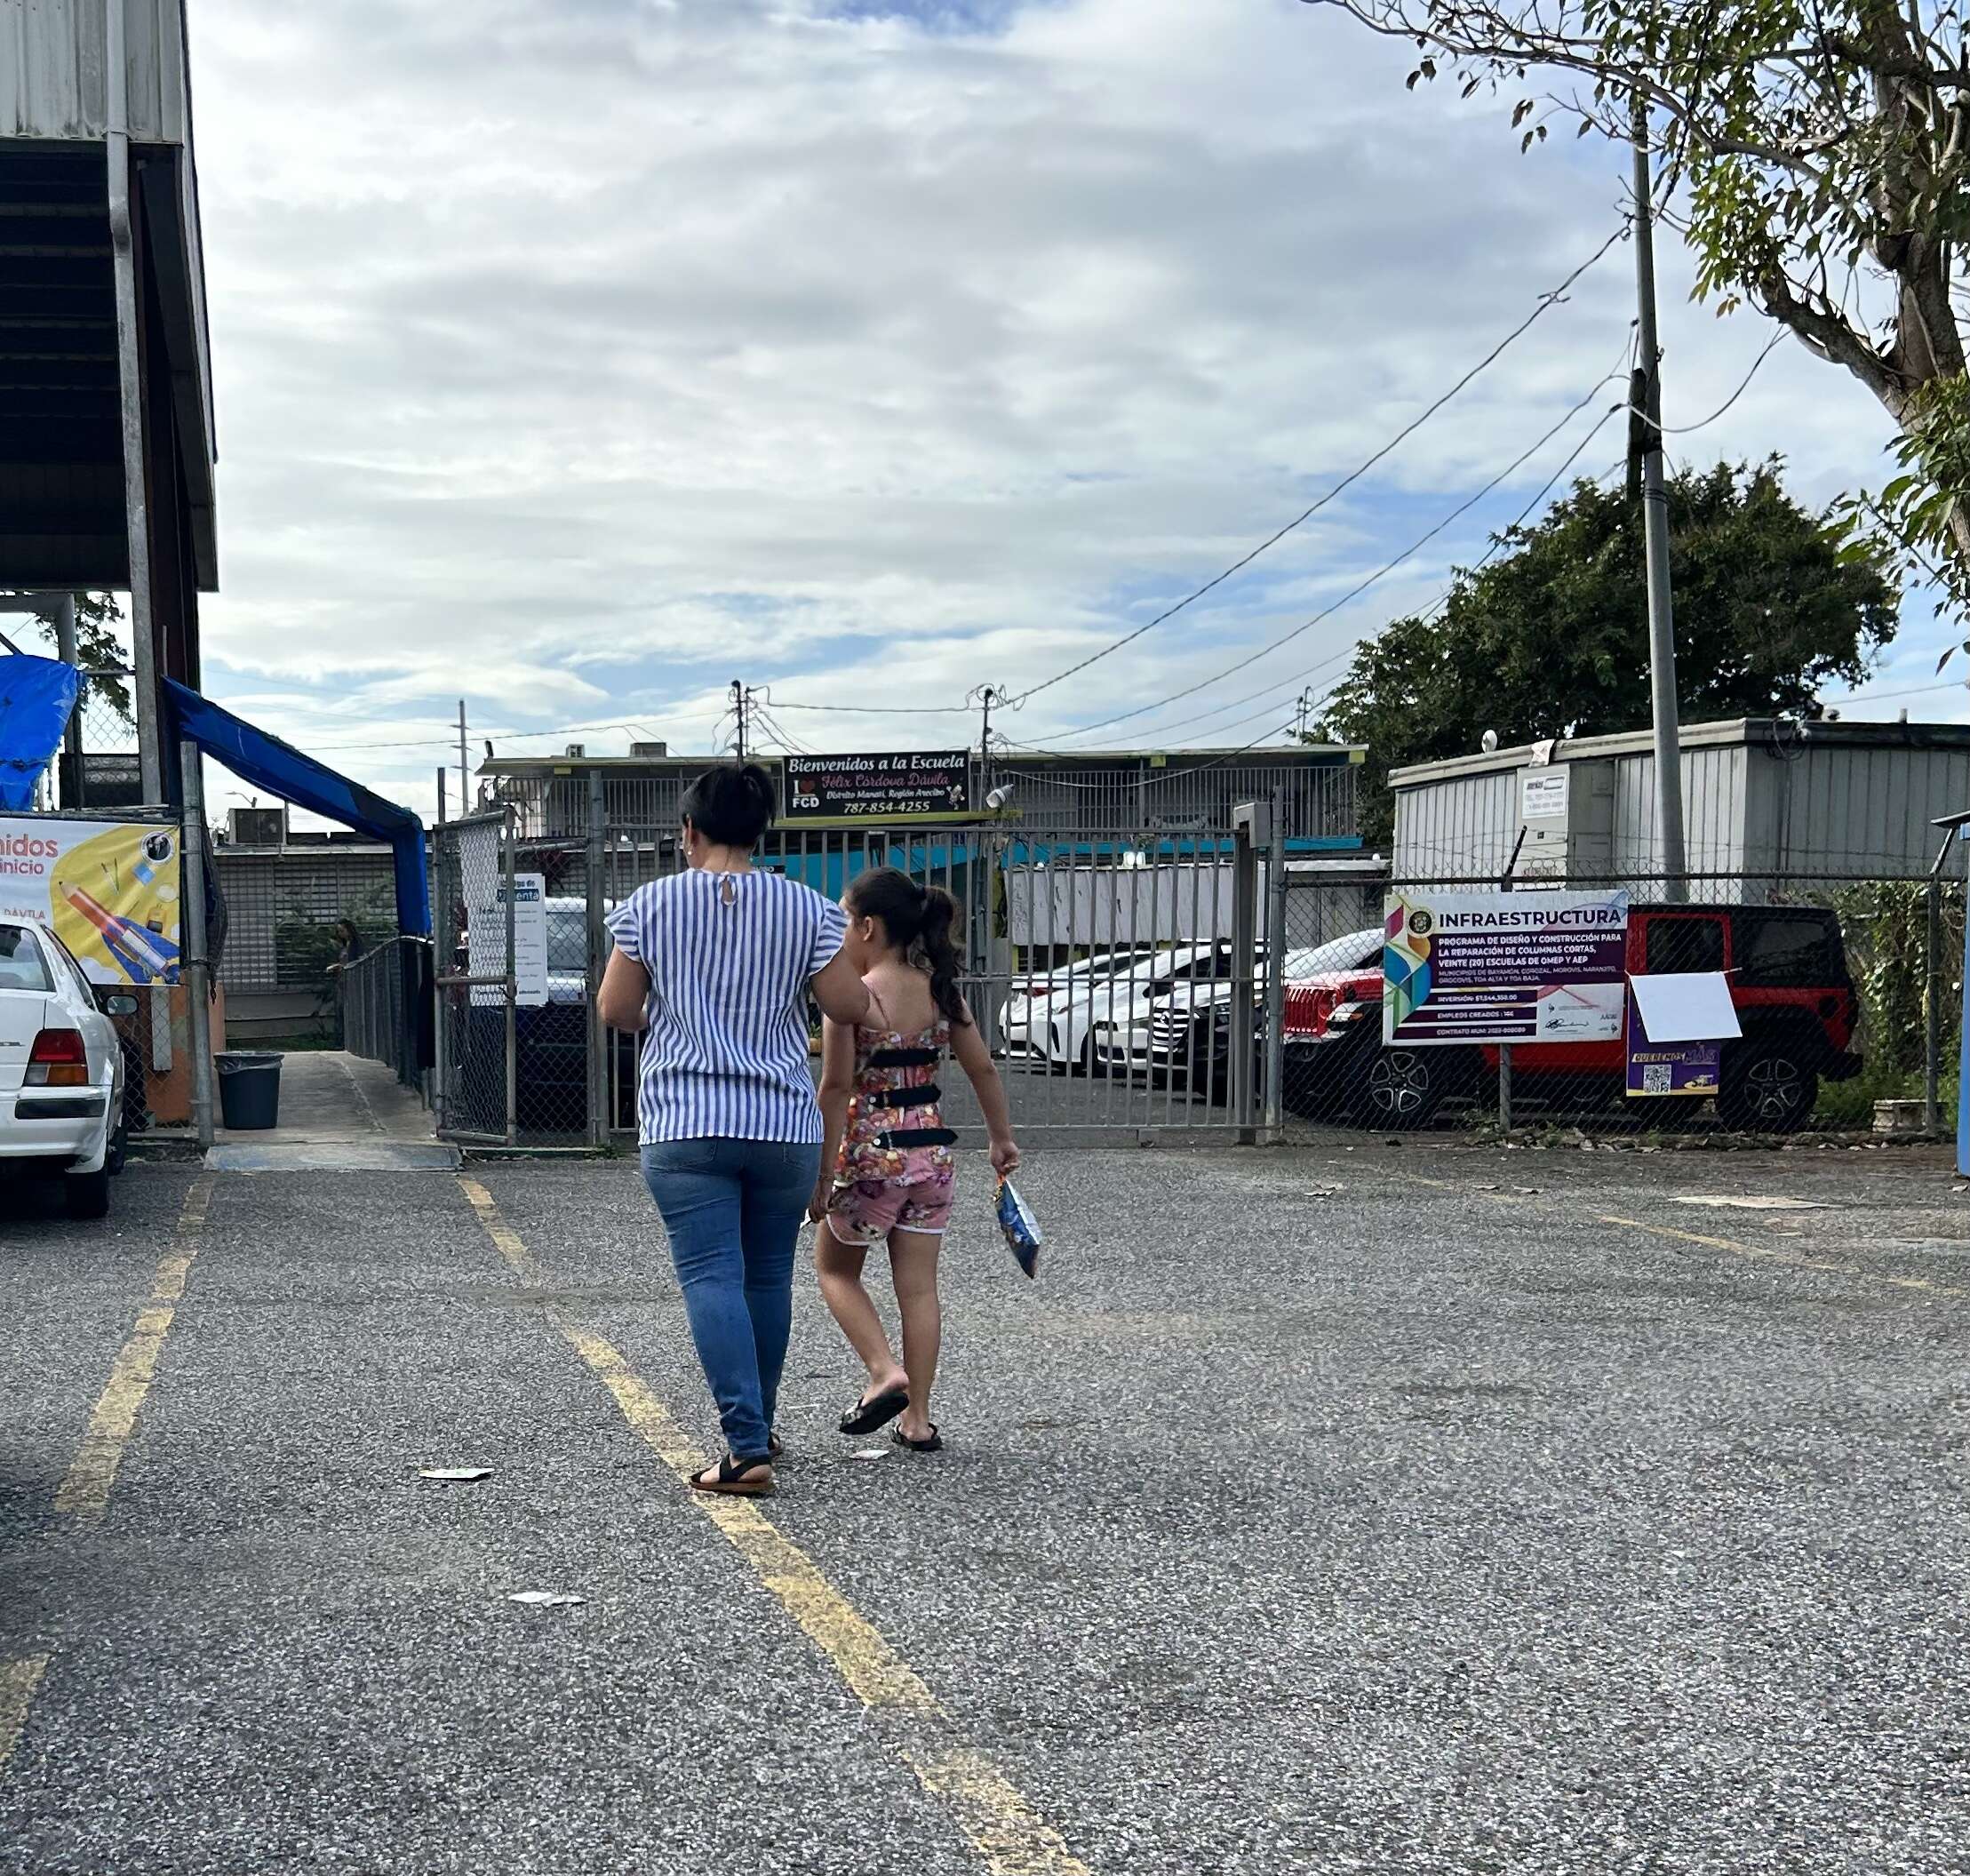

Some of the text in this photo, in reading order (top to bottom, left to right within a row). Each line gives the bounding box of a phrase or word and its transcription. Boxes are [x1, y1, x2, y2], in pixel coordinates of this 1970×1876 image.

[788, 754, 965, 773] Bienvenidos a la Escuela
[855, 773, 906, 788] Córdova
[907, 771, 950, 786] Dávila
[825, 789, 856, 800] Distrito
[888, 788, 916, 799] Región
[916, 787, 945, 798] Arecibo
[792, 796, 820, 809] FCD
[843, 800, 931, 814] 787-854-4255
[1439, 909, 1622, 928] INFRAESTRUCTURA
[1438, 936, 1486, 946] PROGRAMA
[1487, 936, 1499, 945] DE
[1500, 933, 1530, 945] DISEÑO
[1538, 932, 1600, 943] CONSTRUCCIÓN
[1600, 933, 1622, 942] PARA
[1438, 948, 1449, 957] LA
[1450, 946, 1503, 957] REPARACIÓN
[1517, 946, 1562, 954] COLUMNAS
[1563, 945, 1597, 954] CORTAS,
[1438, 959, 1468, 968] VEINTE
[1469, 958, 1485, 969] (20)
[1486, 958, 1527, 967] ESCUELAS
[1528, 957, 1540, 966] DE
[1541, 956, 1564, 965] OMEP
[1572, 955, 1589, 964] AEP
